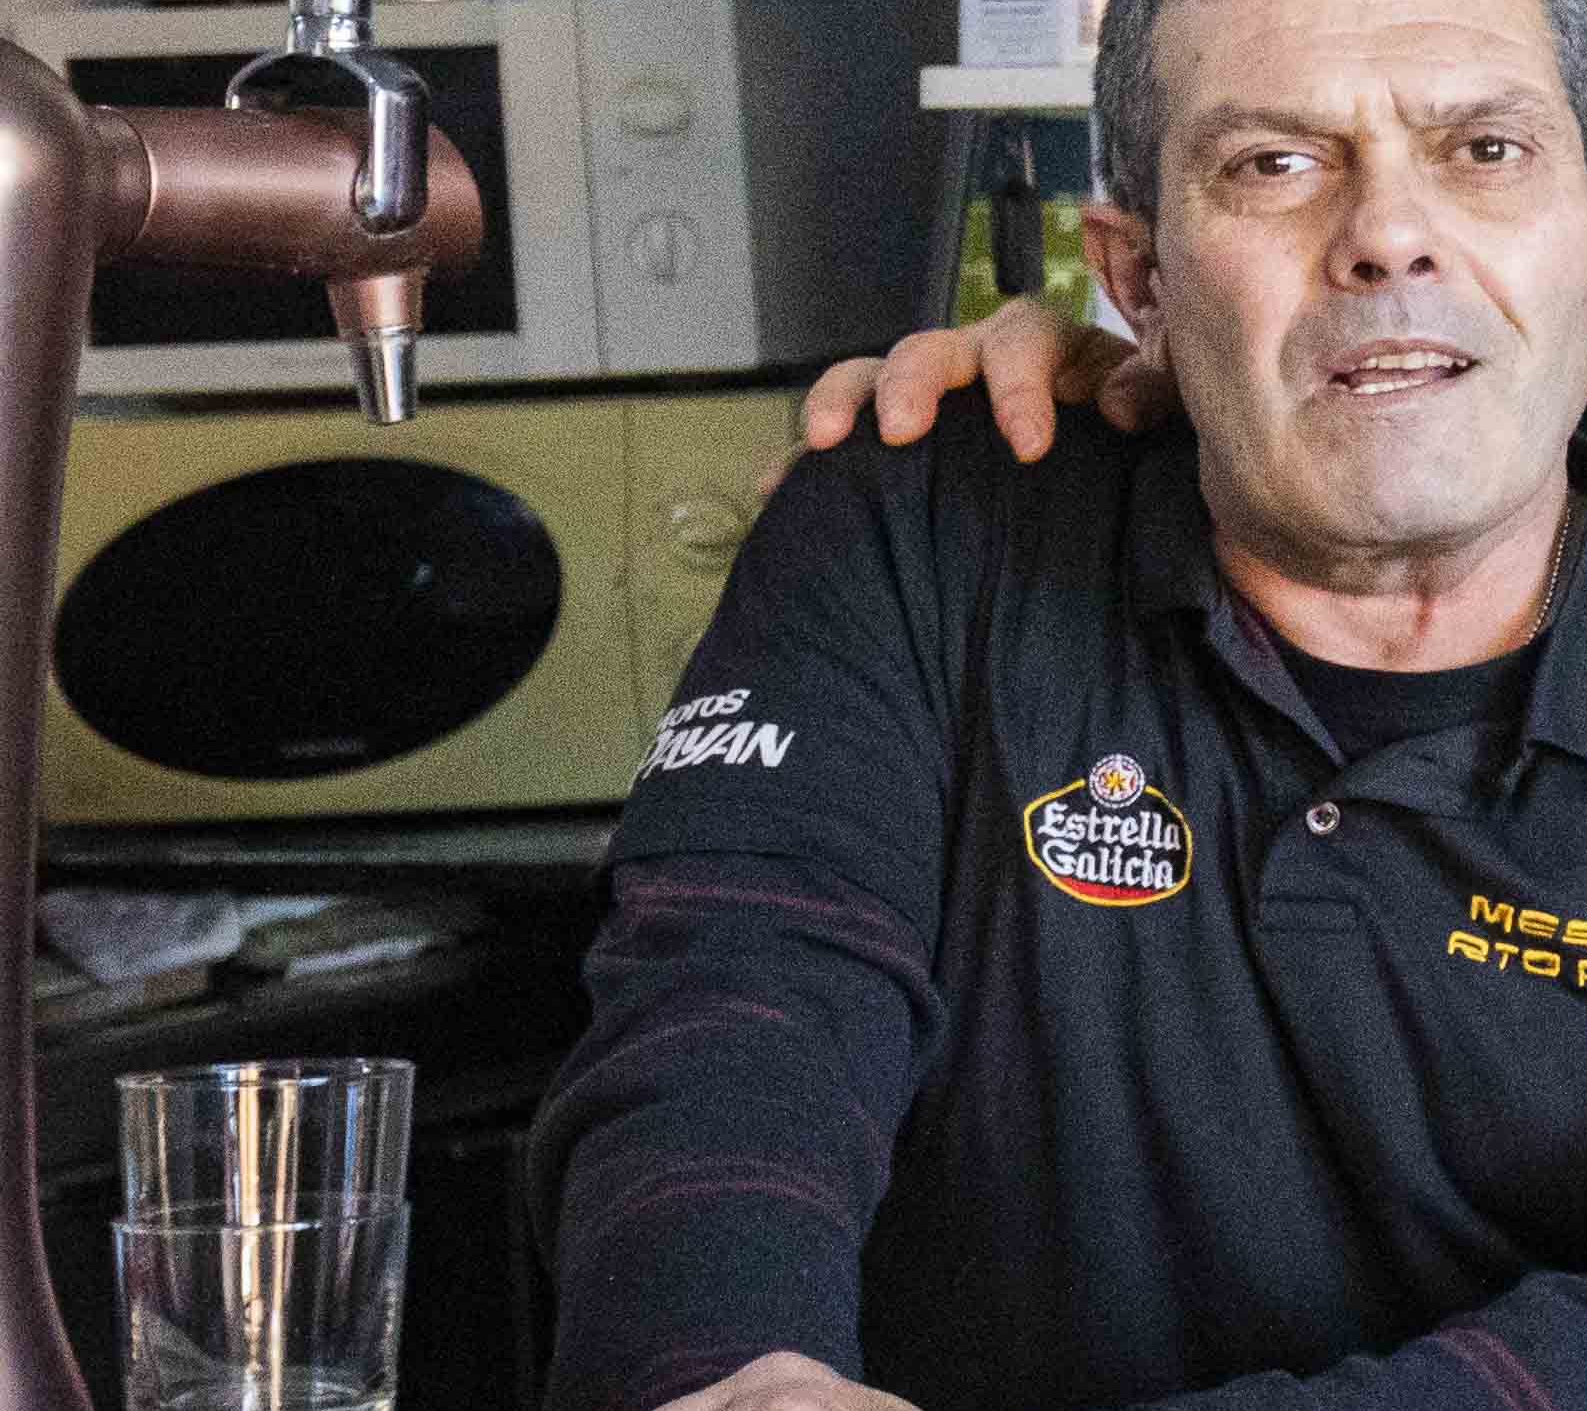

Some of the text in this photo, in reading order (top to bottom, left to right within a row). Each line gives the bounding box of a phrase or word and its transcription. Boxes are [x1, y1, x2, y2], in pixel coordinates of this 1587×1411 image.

[1036, 802, 1181, 852] Estrella
[1041, 841, 1176, 891] Galicia
[1446, 929, 1562, 979] RTO
